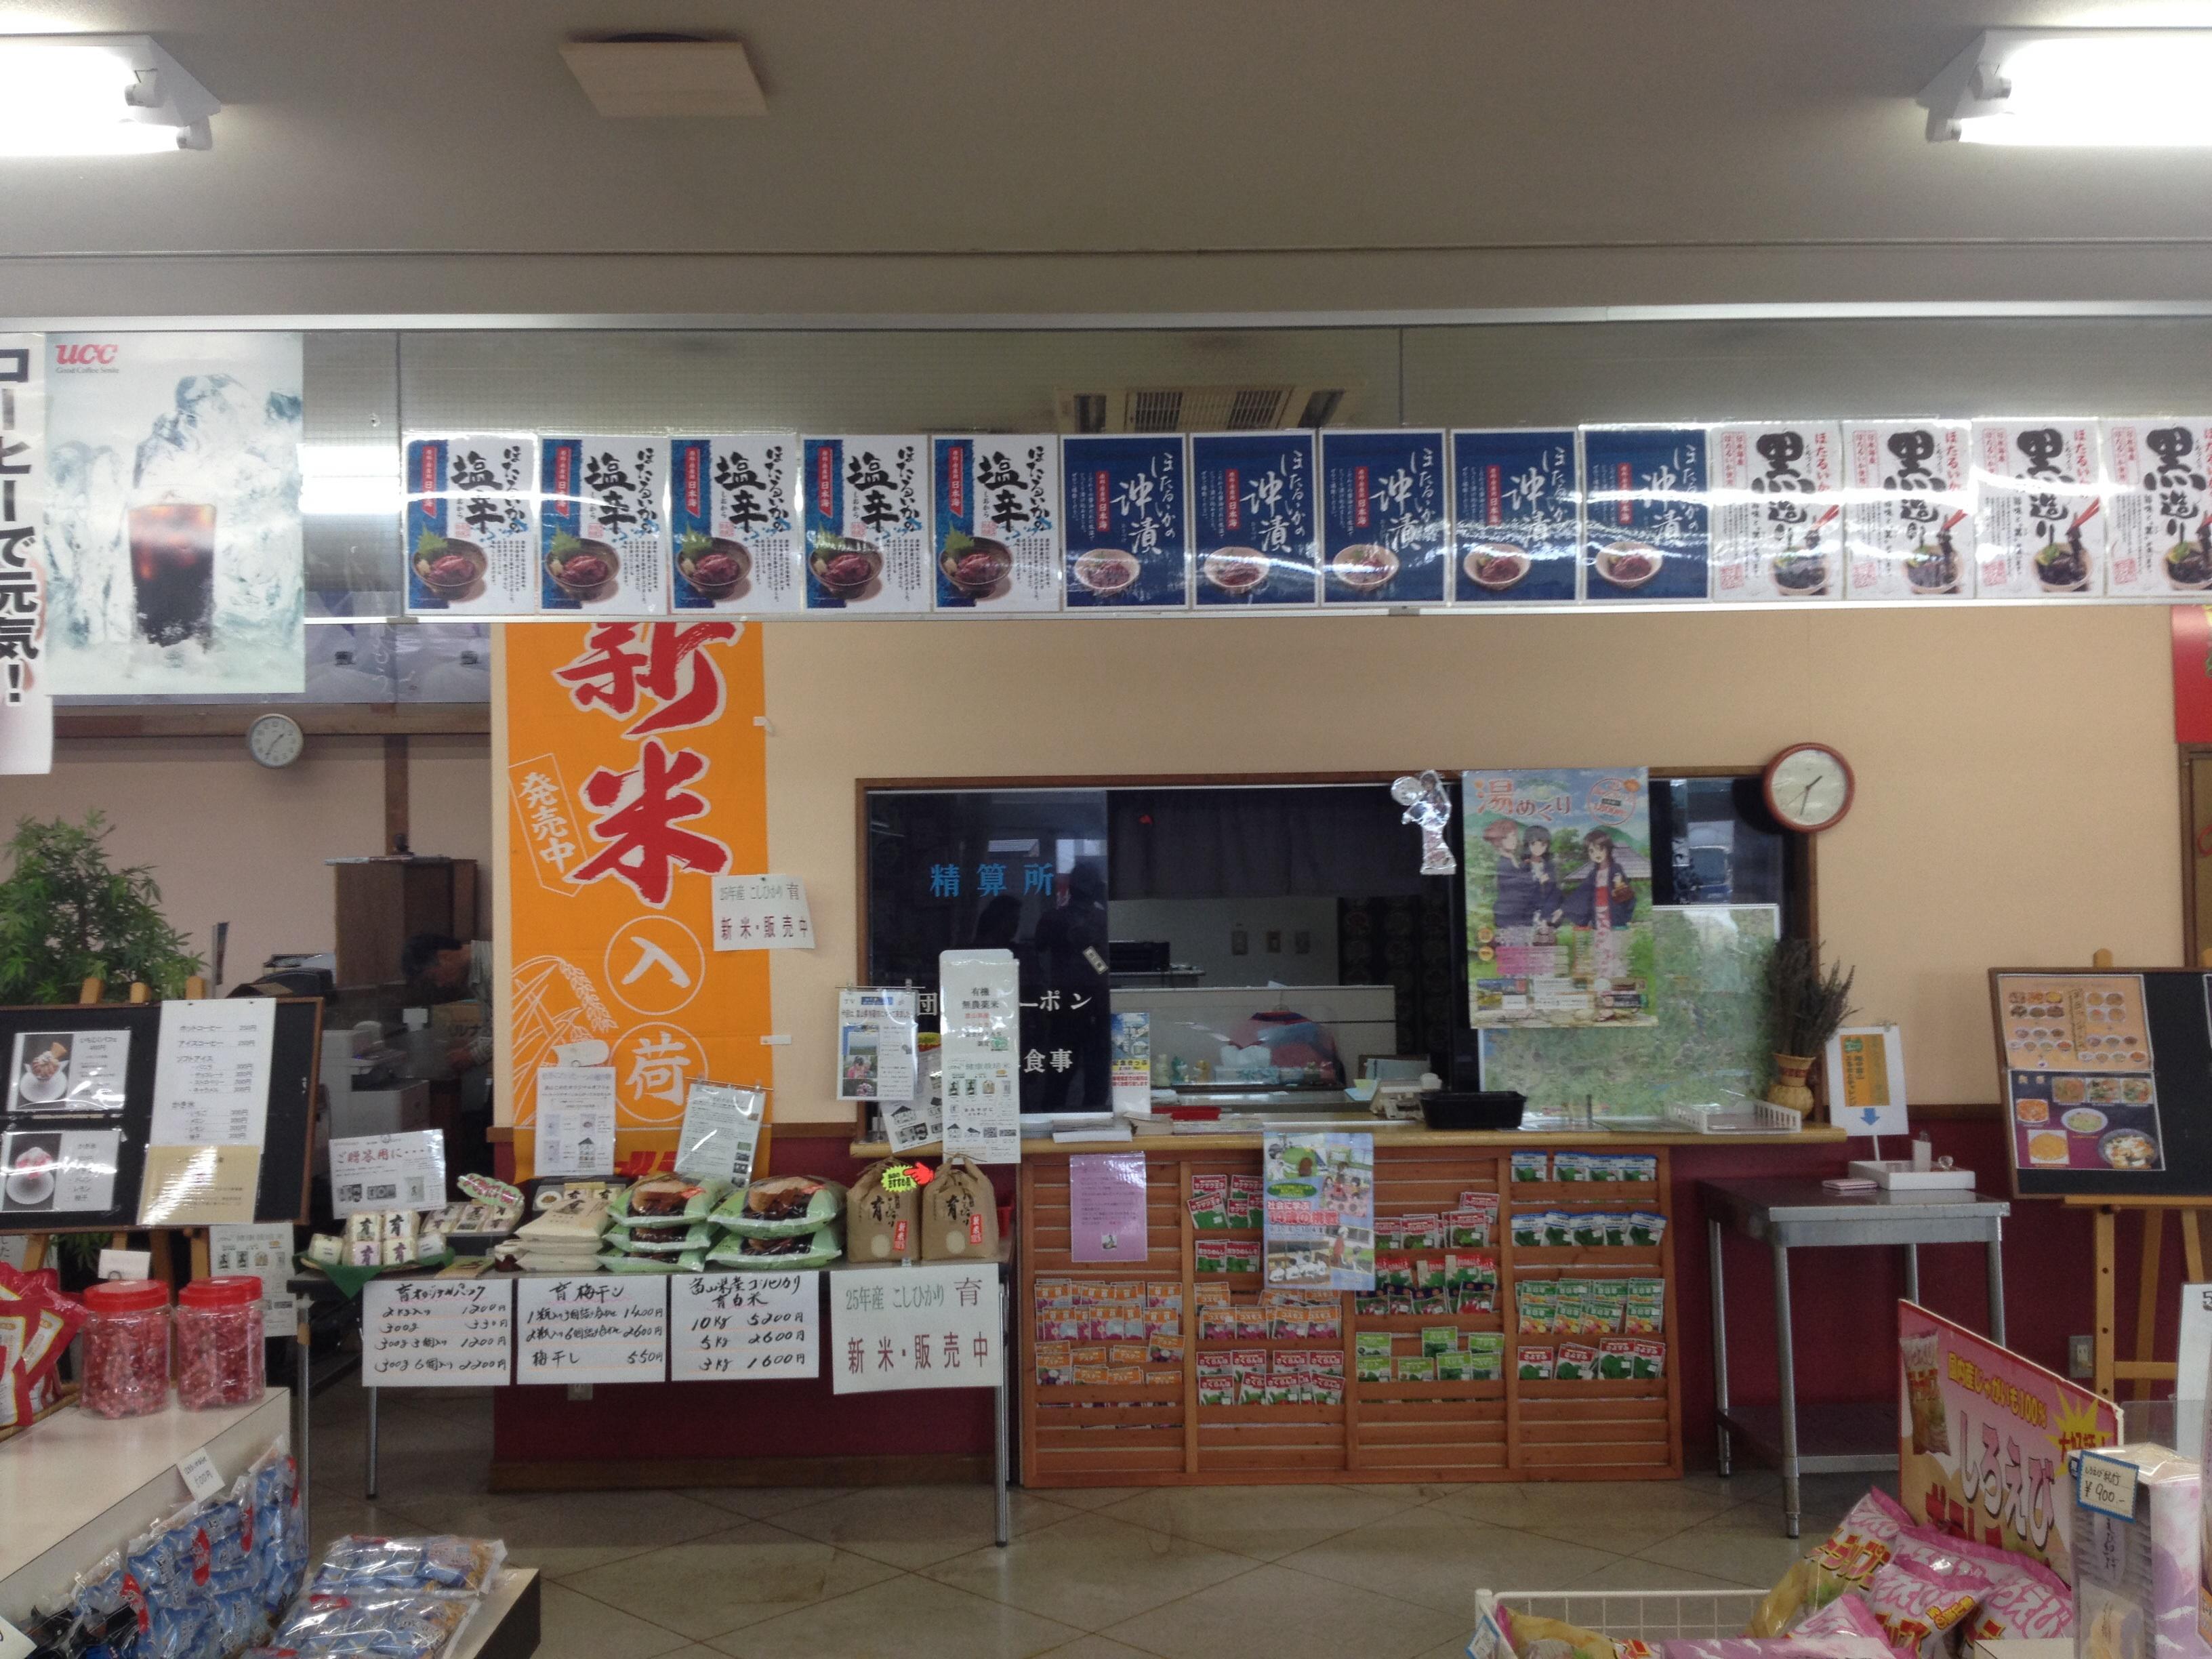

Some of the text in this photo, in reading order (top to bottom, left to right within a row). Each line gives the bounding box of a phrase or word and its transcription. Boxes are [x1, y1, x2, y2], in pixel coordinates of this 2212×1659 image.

[584, 452, 636, 535] 塩辛
[714, 451, 769, 533] 塩辛
[846, 451, 900, 533] 塩辛
[977, 451, 1030, 533] 塩辛
[518, 772, 576, 874] 発売中
[930, 863, 1055, 897] 精算所
[893, 1286, 945, 1309] こしひかり
[954, 1277, 983, 1307] 育
[1959, 1410, 2057, 1552] しろえび
